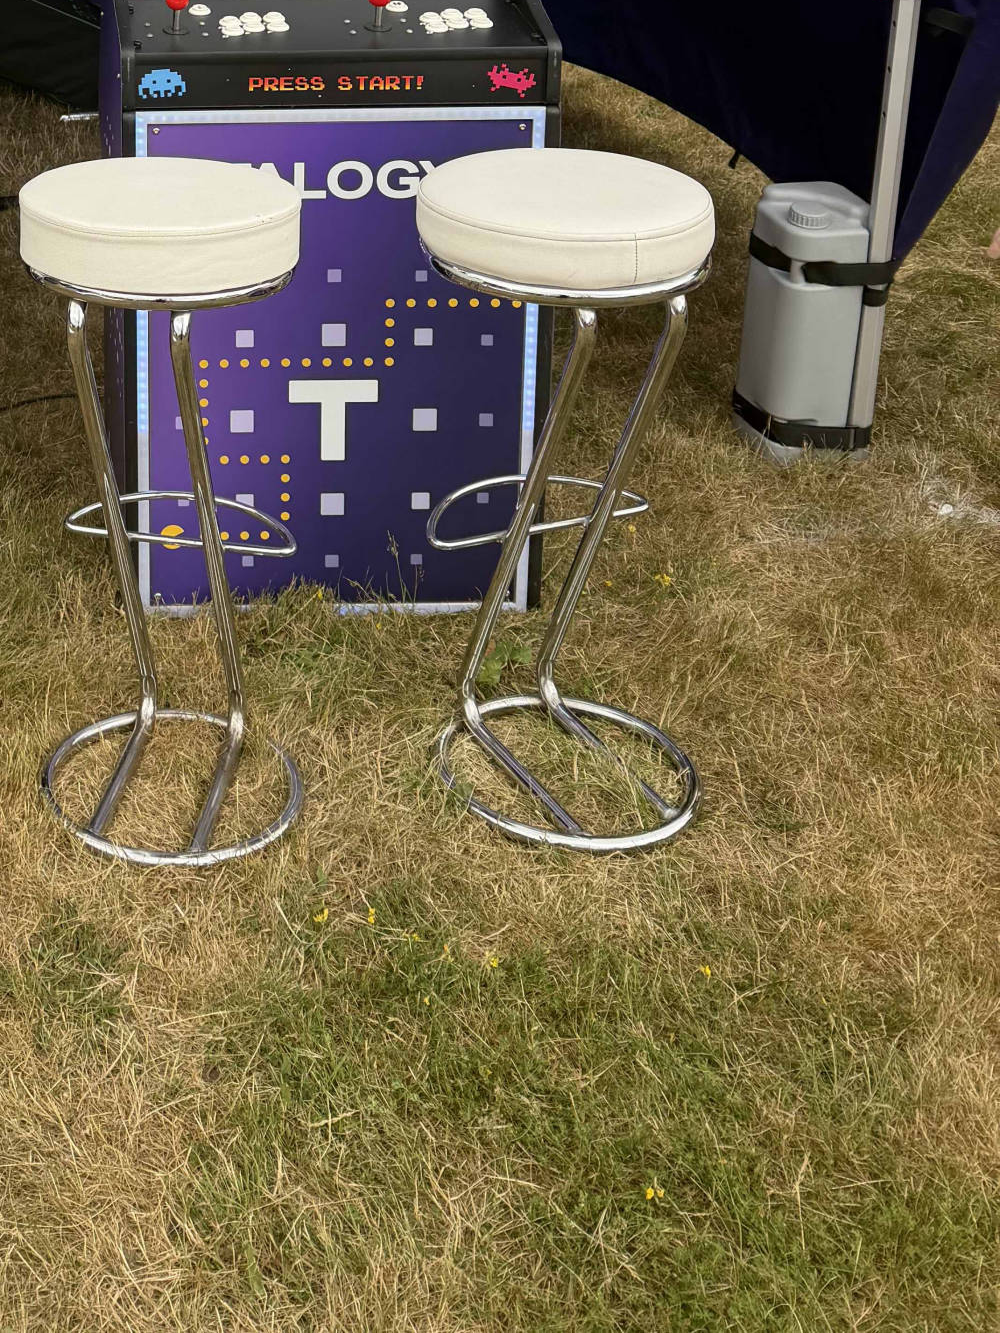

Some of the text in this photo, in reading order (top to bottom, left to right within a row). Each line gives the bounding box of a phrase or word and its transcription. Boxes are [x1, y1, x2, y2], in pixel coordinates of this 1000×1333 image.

[249, 75, 424, 91] PRESS START!
[289, 380, 379, 460] T
